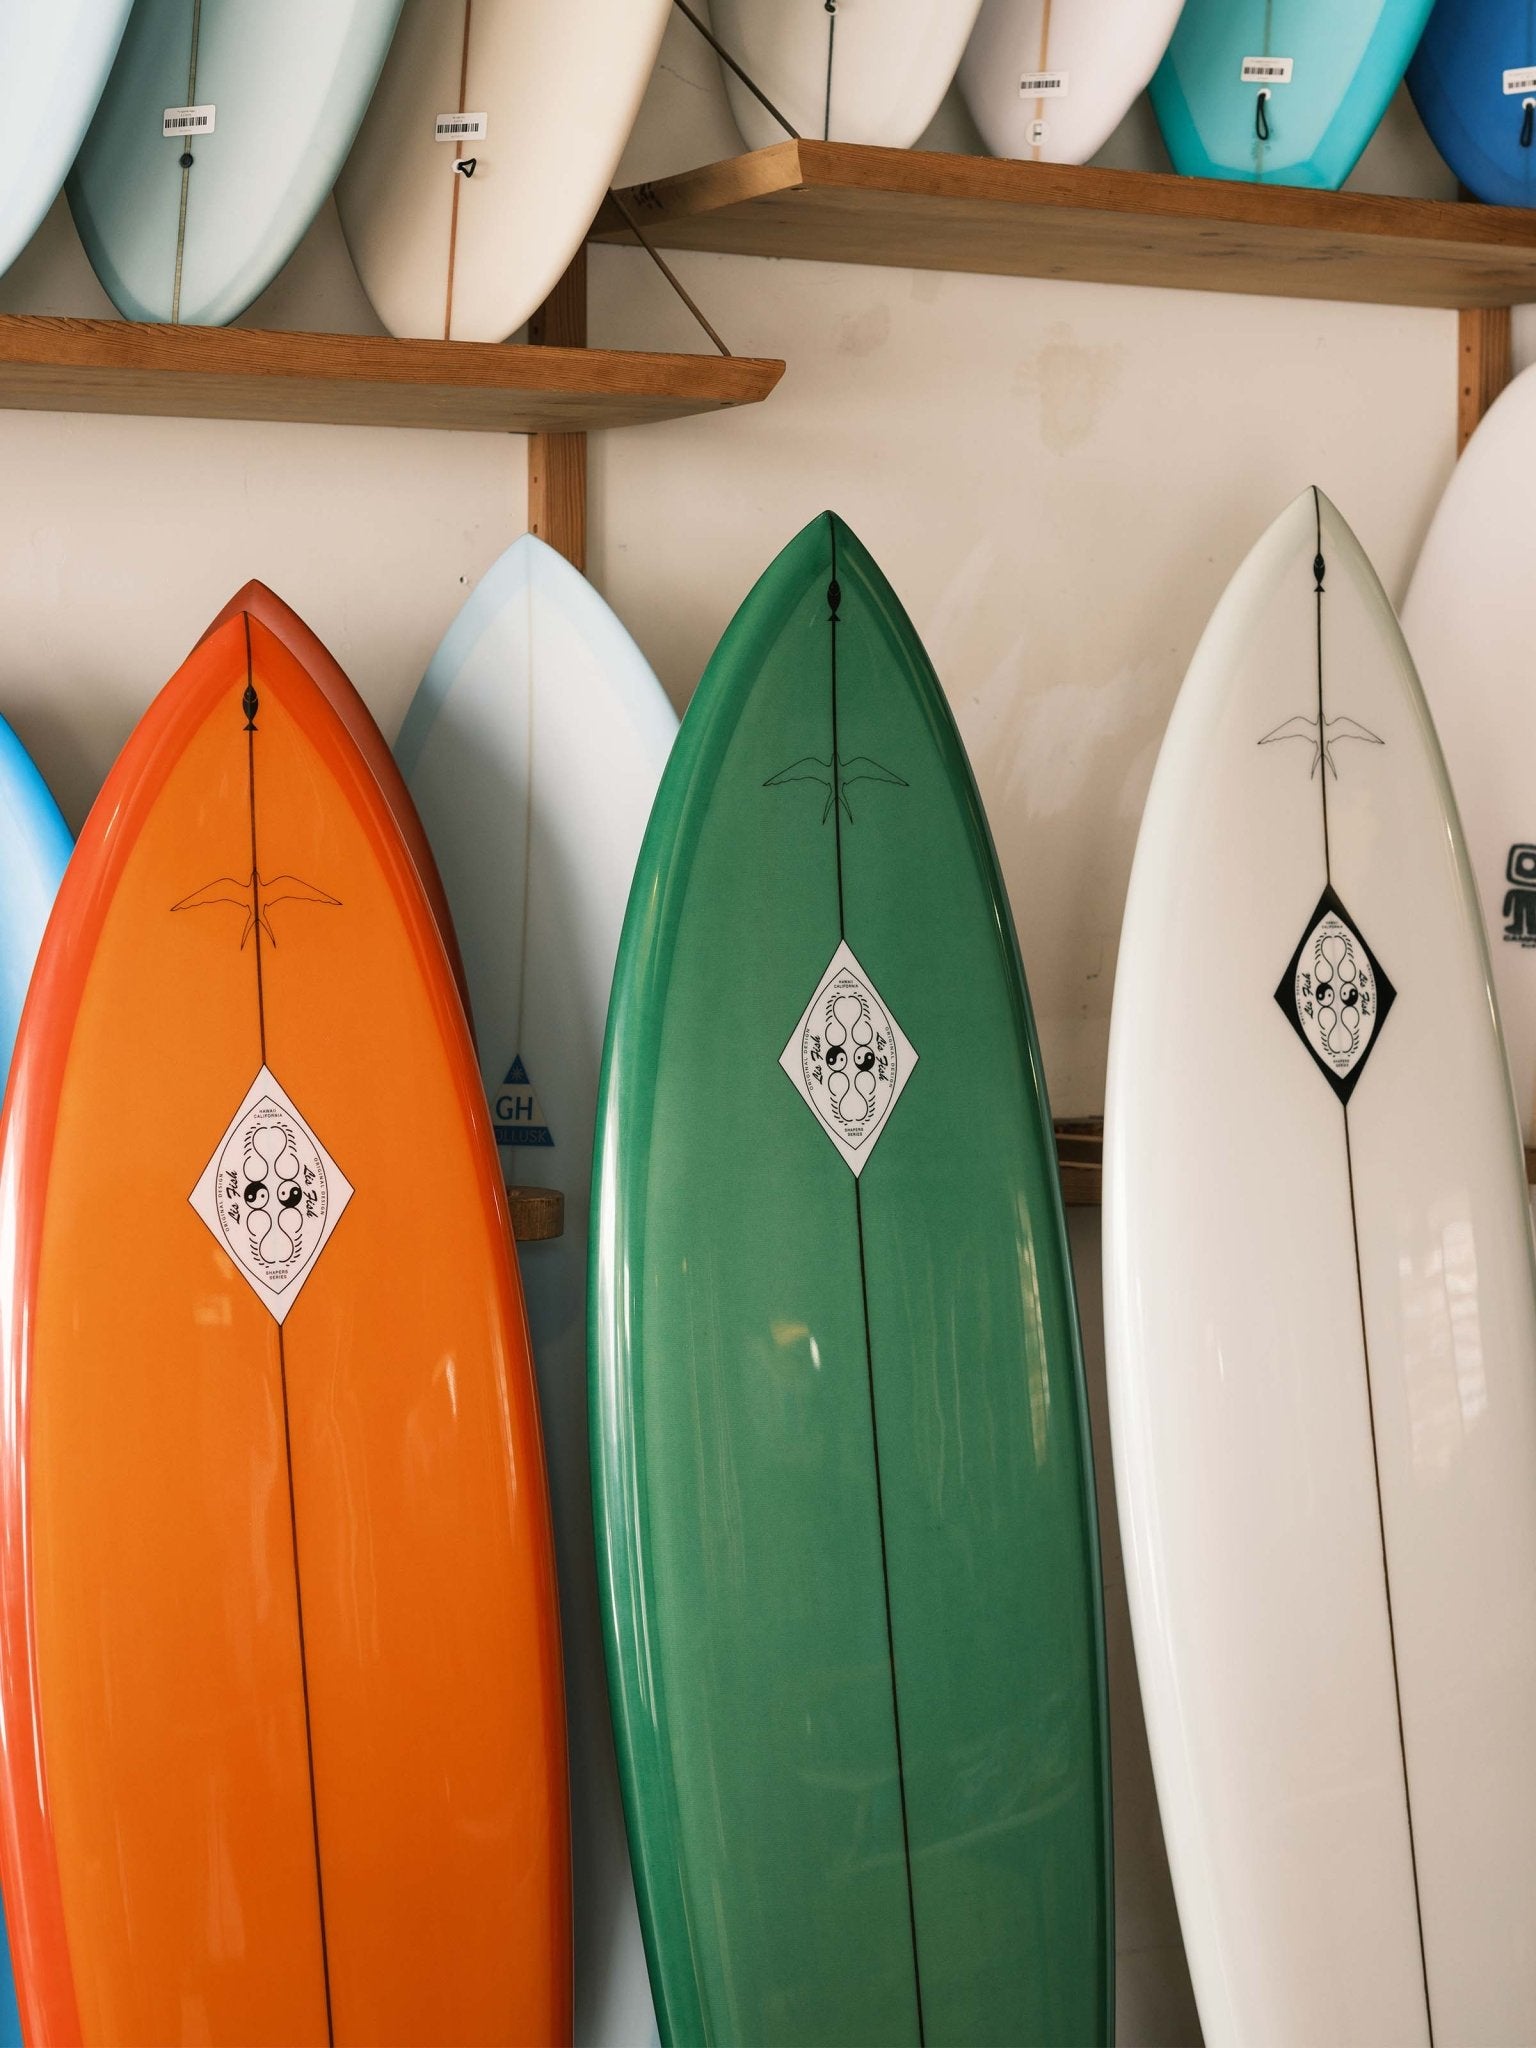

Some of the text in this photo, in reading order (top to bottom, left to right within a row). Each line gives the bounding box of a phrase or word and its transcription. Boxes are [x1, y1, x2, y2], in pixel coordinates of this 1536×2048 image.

[1302, 973, 1314, 1019] Lis Fish
[1359, 969, 1370, 1016] Lis Fish
[810, 1035, 824, 1086] Lis Fish
[876, 1032, 889, 1082] Lis Fish
[496, 1096, 532, 1120] GH
[495, 1128, 547, 1143] OLLUSK
[303, 1164, 319, 1219] Lis Fish
[313, 1157, 324, 1190] ORIGINAL
[219, 1201, 230, 1232] ORIGINAL
[226, 1169, 241, 1225] Lis Fish
